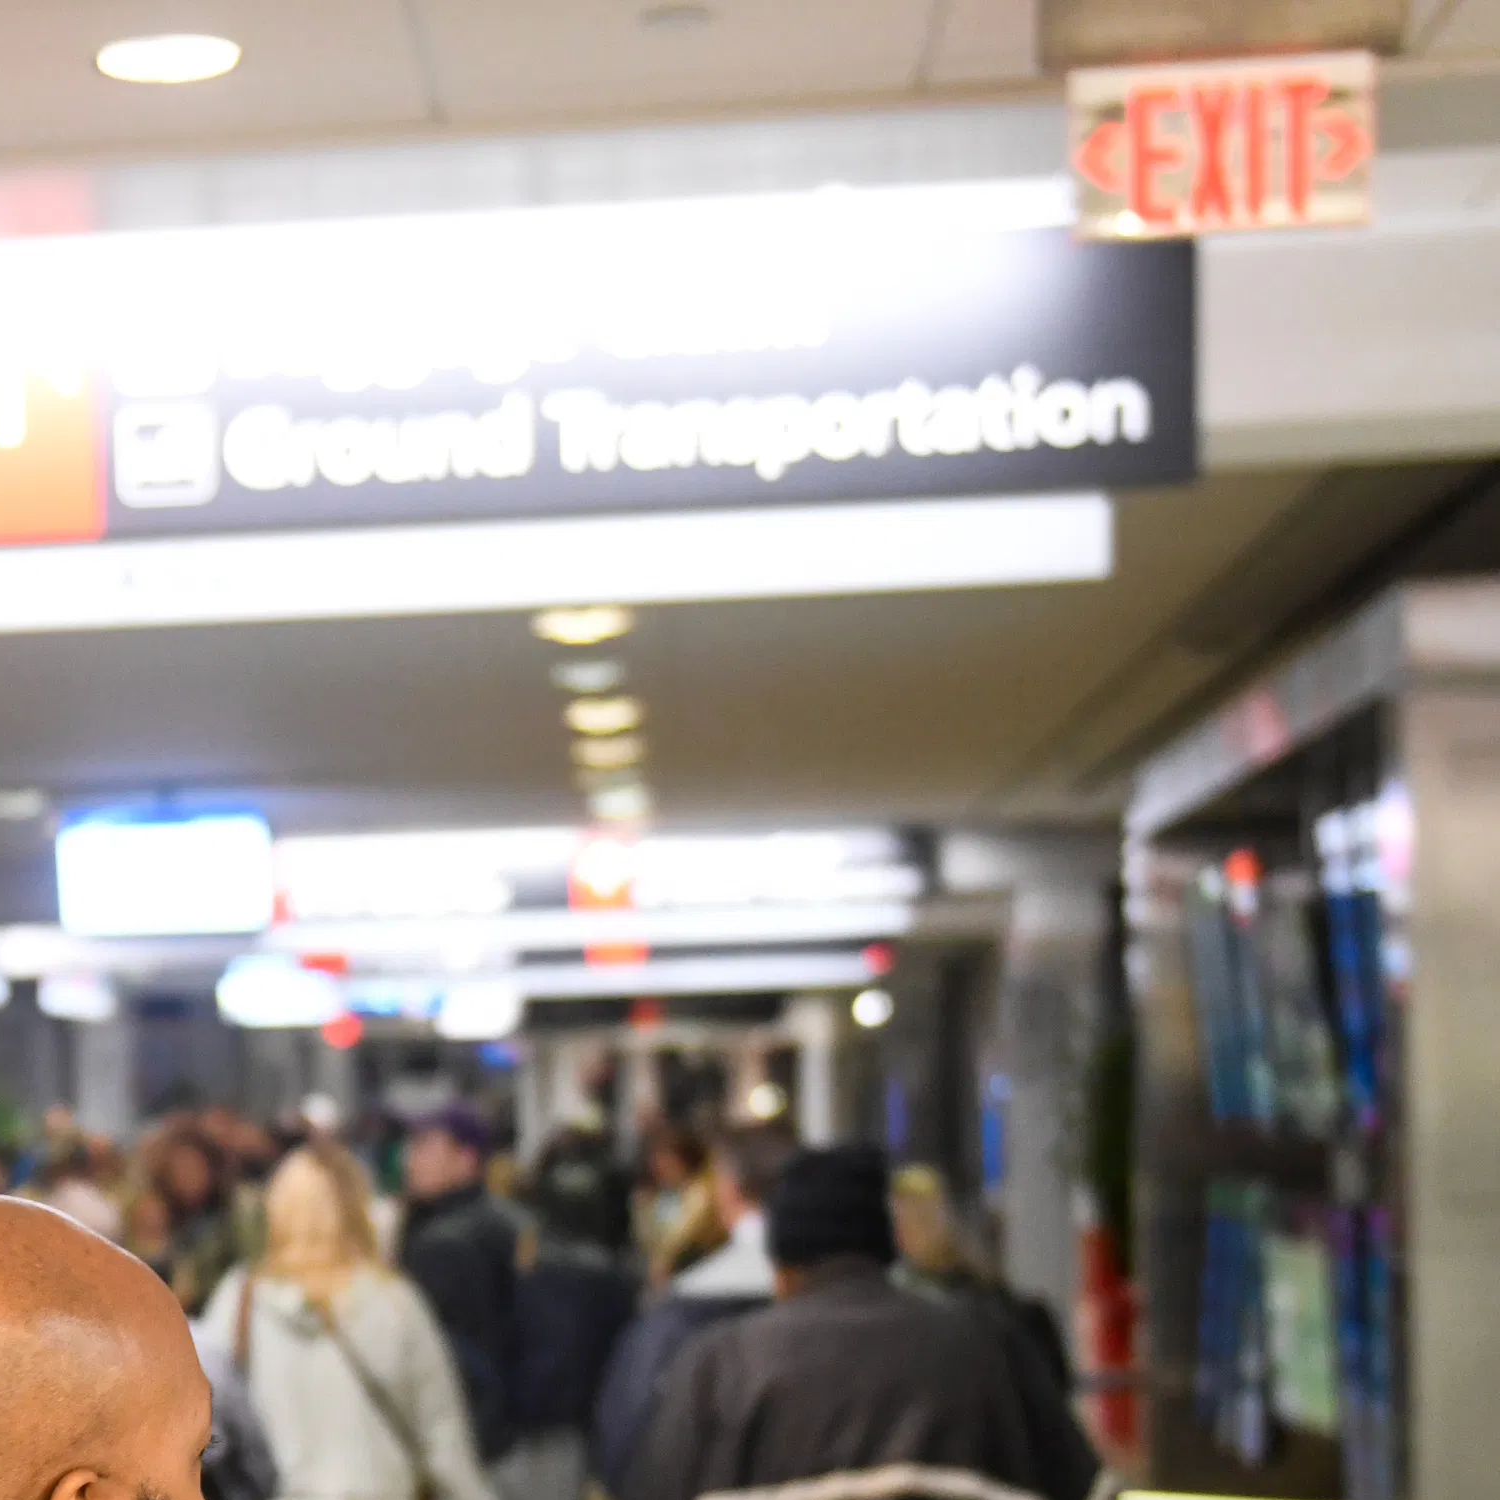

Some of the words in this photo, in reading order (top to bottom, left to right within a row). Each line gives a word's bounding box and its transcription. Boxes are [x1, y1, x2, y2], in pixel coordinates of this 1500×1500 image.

[1126, 78, 1330, 223] EXIT
[224, 393, 534, 491] Ground
[542, 364, 1149, 480] Transportation
